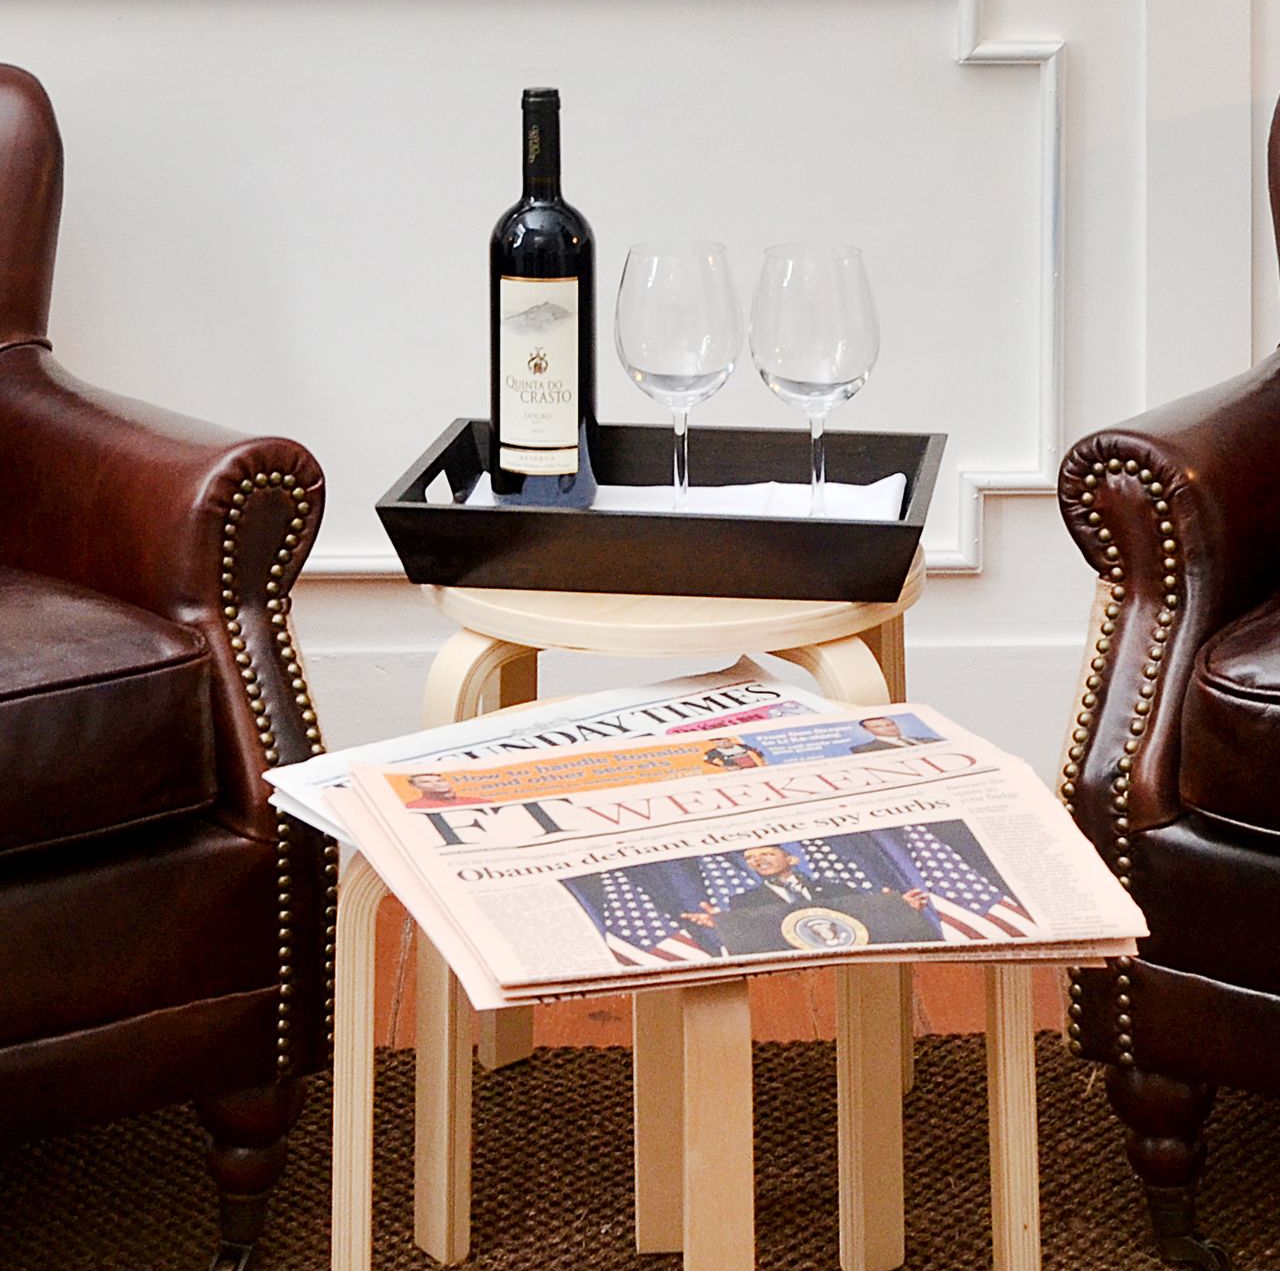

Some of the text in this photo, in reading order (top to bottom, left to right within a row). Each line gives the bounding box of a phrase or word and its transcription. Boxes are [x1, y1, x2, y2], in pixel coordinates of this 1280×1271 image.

[505, 375, 563, 393] QUINTA DO
[520, 389, 572, 404] CRASTO
[630, 683, 782, 725] TIMES
[452, 770, 502, 786] How
[506, 767, 531, 778] to
[534, 755, 610, 778] handle
[613, 744, 701, 764] Ronaldo
[527, 769, 586, 785] other
[593, 759, 672, 776] secrets
[408, 796, 577, 849] FT
[582, 752, 977, 826] WEEKEND
[456, 859, 573, 883] Obama
[581, 837, 692, 866] defiant
[700, 815, 809, 847] despite
[812, 808, 863, 829] spy
[868, 794, 952, 819] curbs
